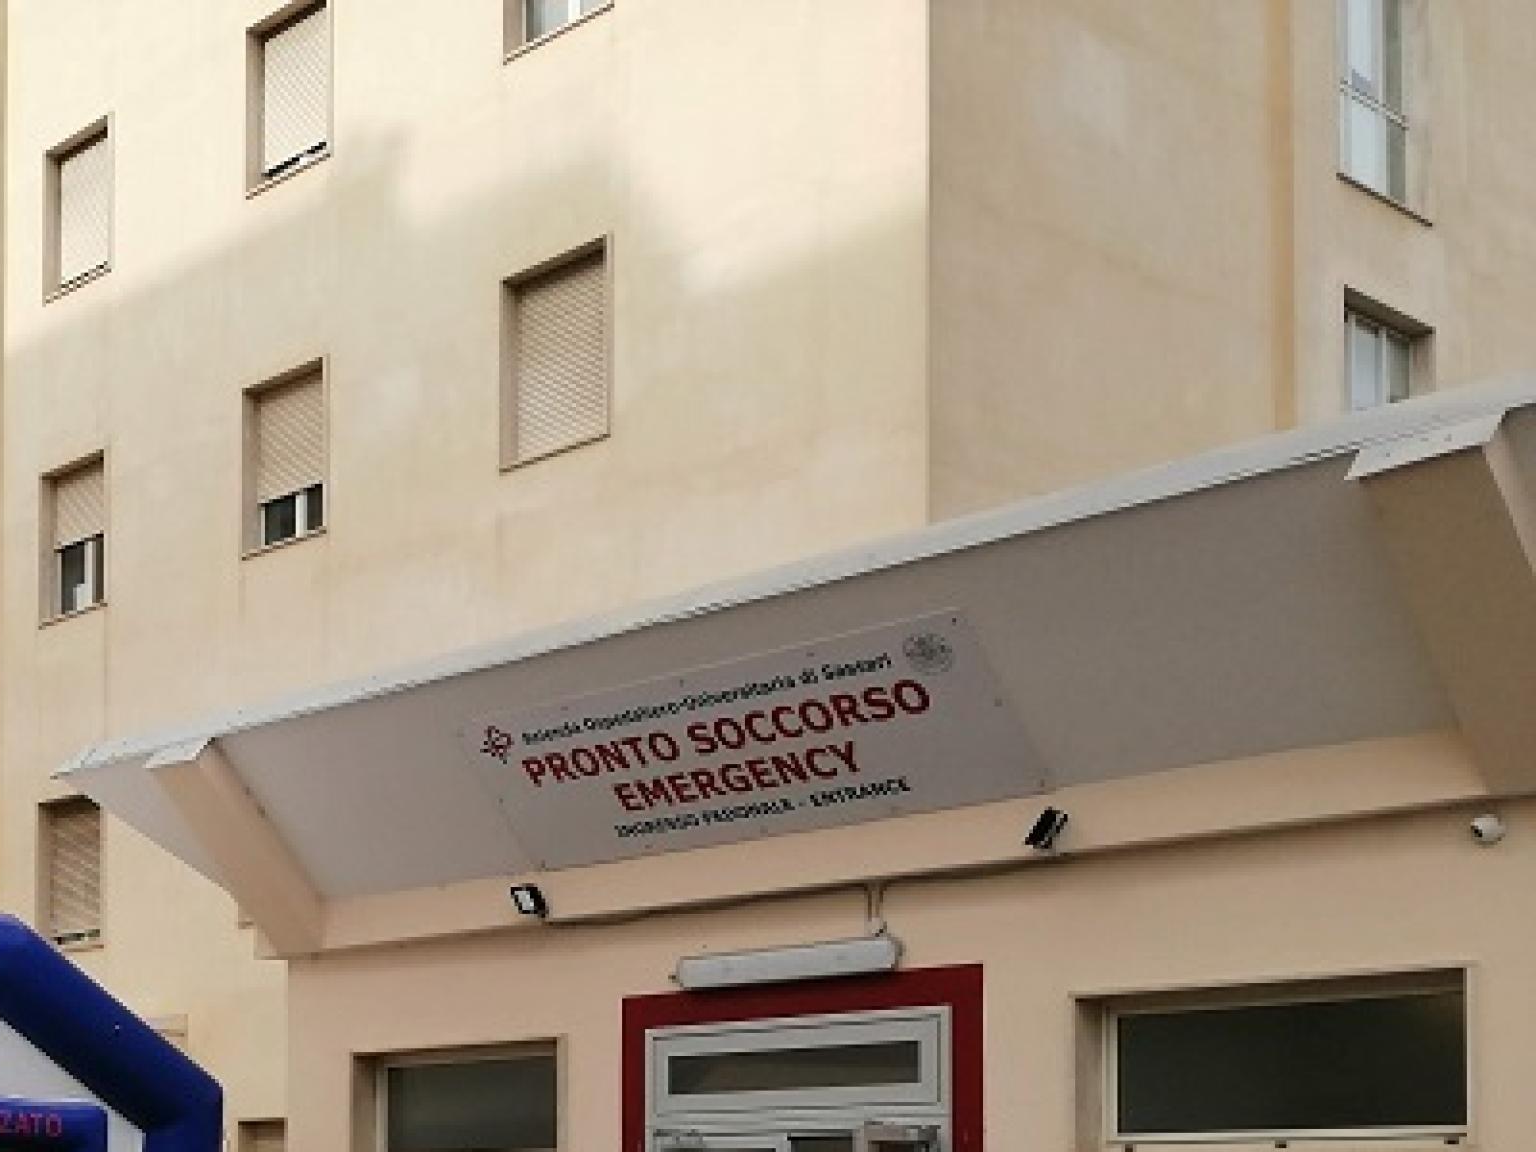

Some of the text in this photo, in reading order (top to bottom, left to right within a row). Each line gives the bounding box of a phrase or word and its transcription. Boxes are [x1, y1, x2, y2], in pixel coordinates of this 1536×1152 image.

[821, 652, 893, 681] Sassari
[522, 679, 931, 787] PRONTO SOCCORSO
[612, 741, 861, 811] EMERGENCY
[809, 776, 912, 809] ENTRANCE
